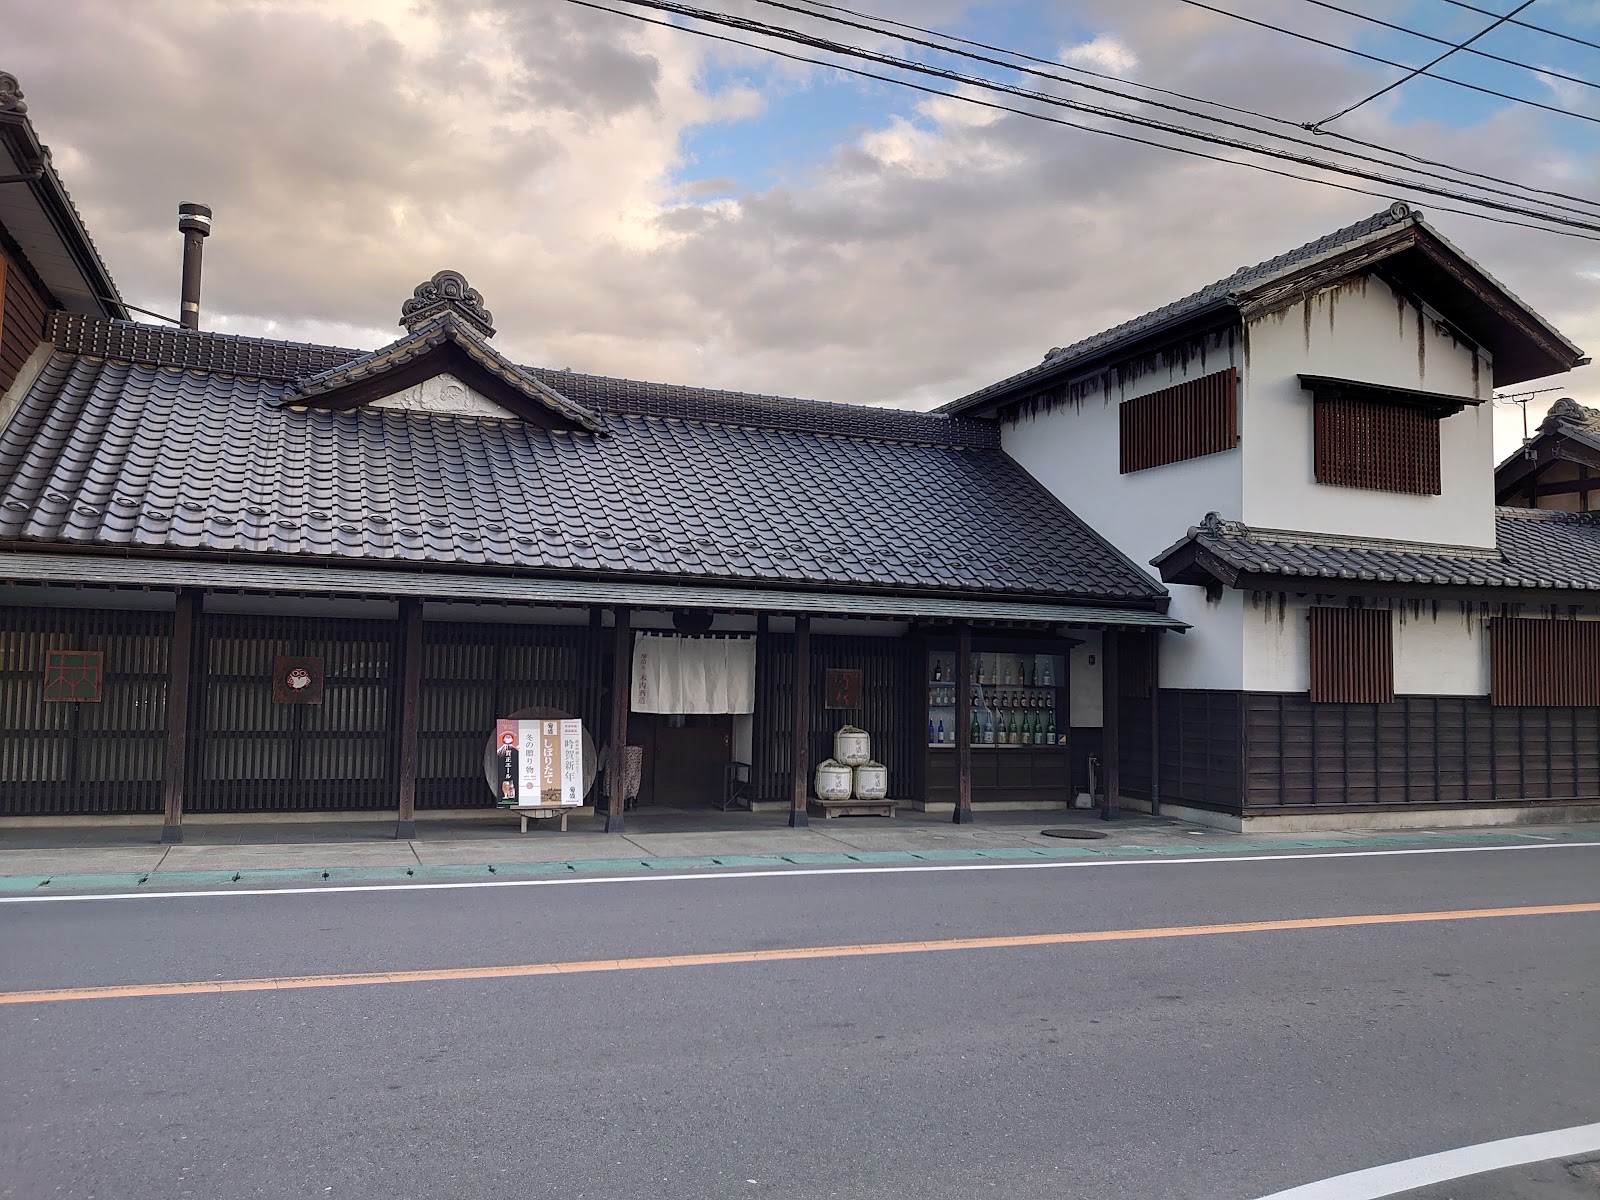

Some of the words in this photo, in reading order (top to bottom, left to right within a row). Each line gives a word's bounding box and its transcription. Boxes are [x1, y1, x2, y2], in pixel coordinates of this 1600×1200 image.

[525, 733, 534, 774] 冬の贈り物
[543, 738, 554, 784] しぼりたて
